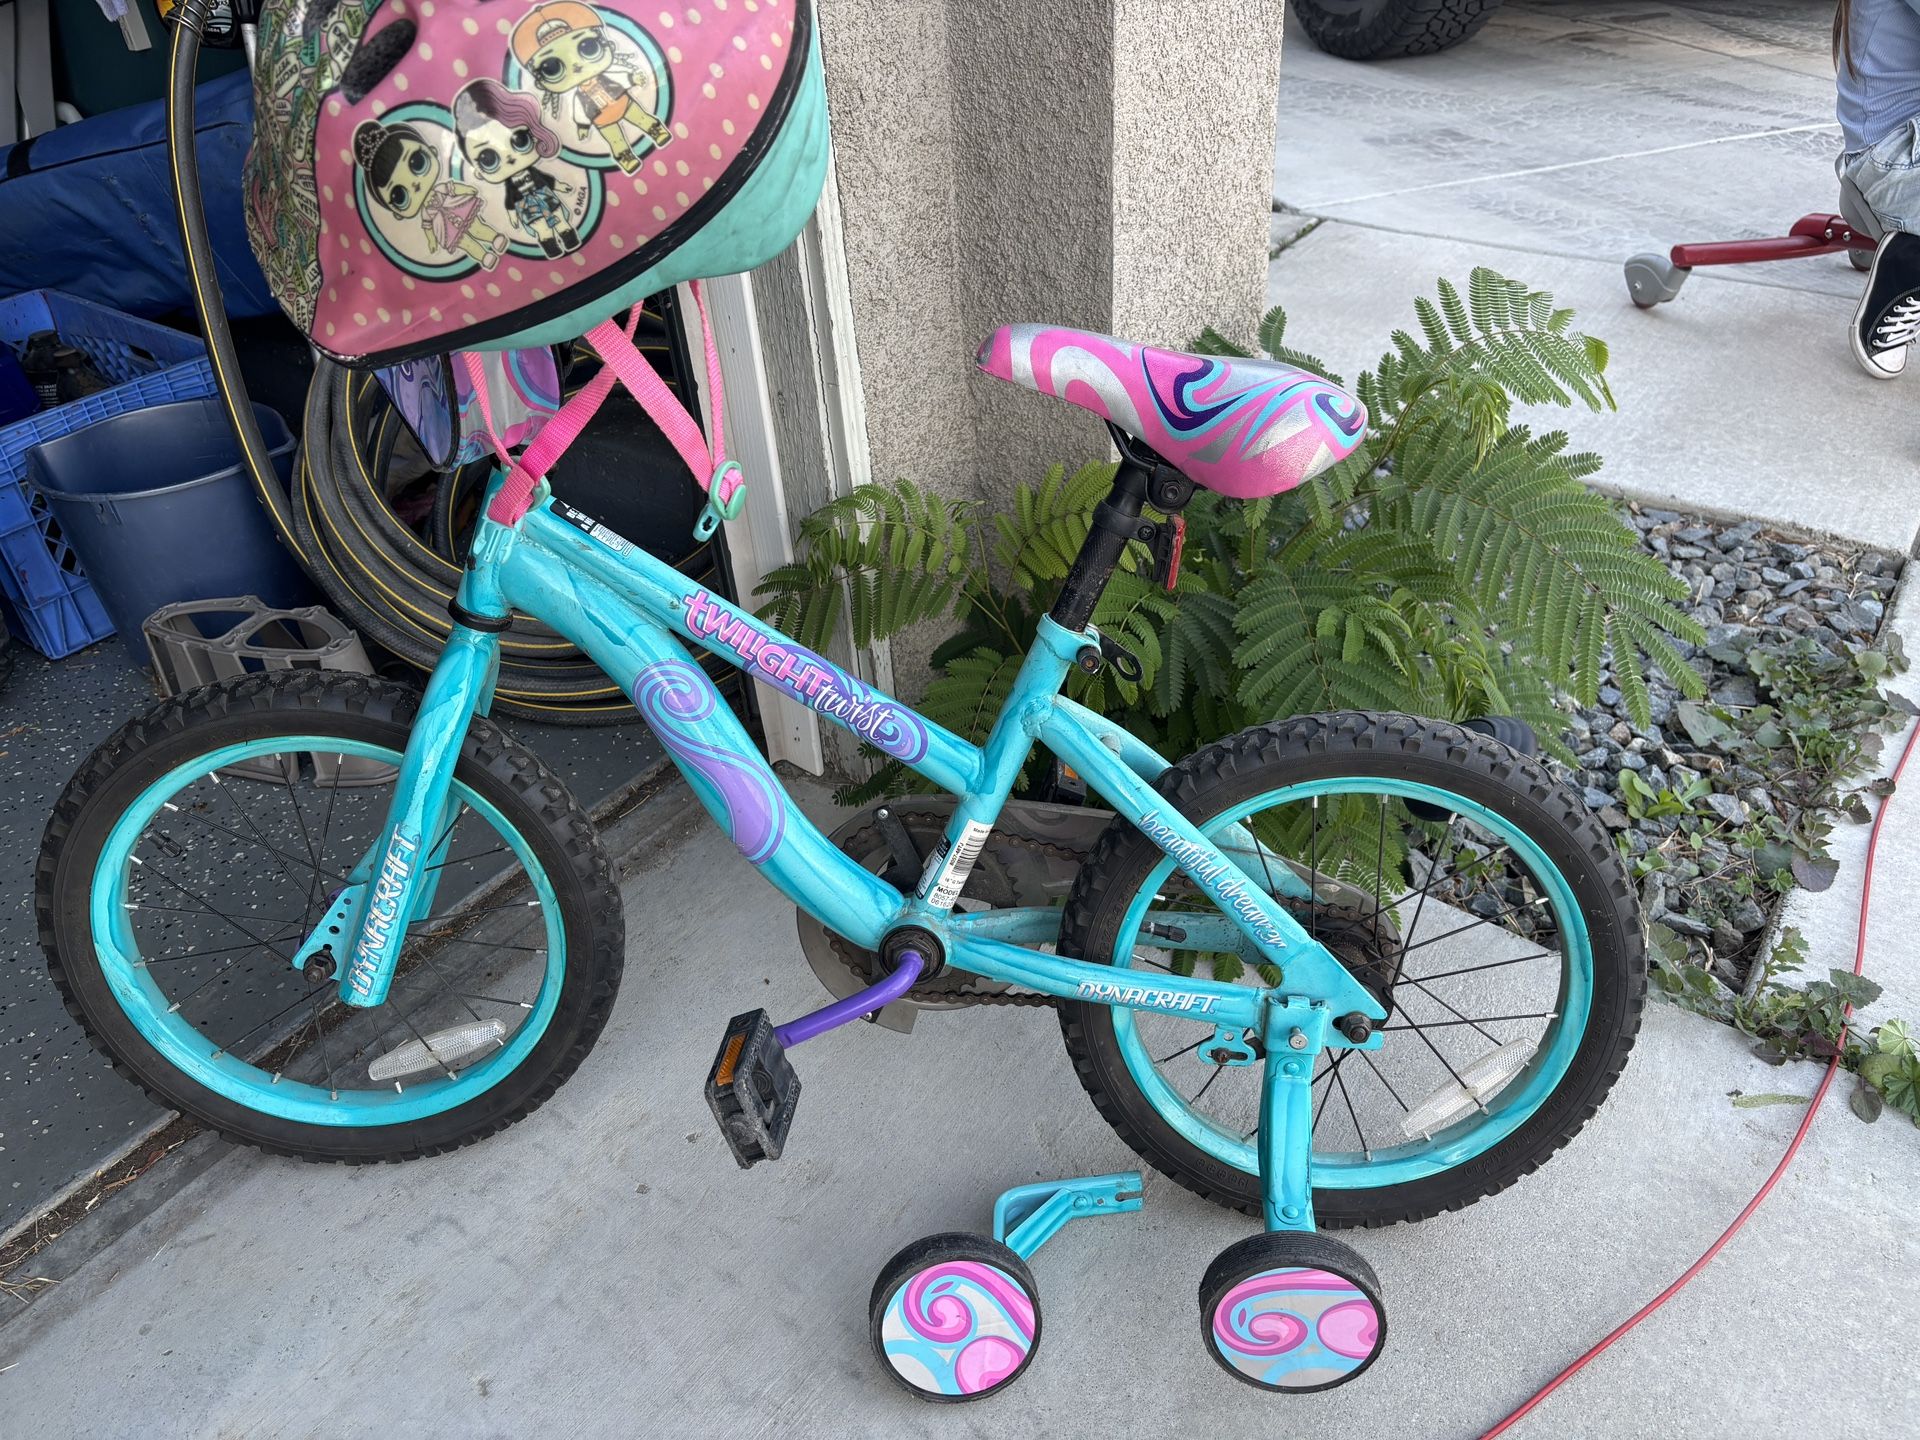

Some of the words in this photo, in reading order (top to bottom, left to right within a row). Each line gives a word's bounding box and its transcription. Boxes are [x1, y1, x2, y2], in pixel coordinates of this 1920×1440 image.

[577, 186, 588, 208] MGA
[813, 683, 894, 742] twist
[1138, 809, 1230, 888] beautiful
[1215, 876, 1288, 950] dreamer
[349, 823, 417, 997] DYNACRAFT
[1076, 980, 1222, 1014] DYNACRAFT
